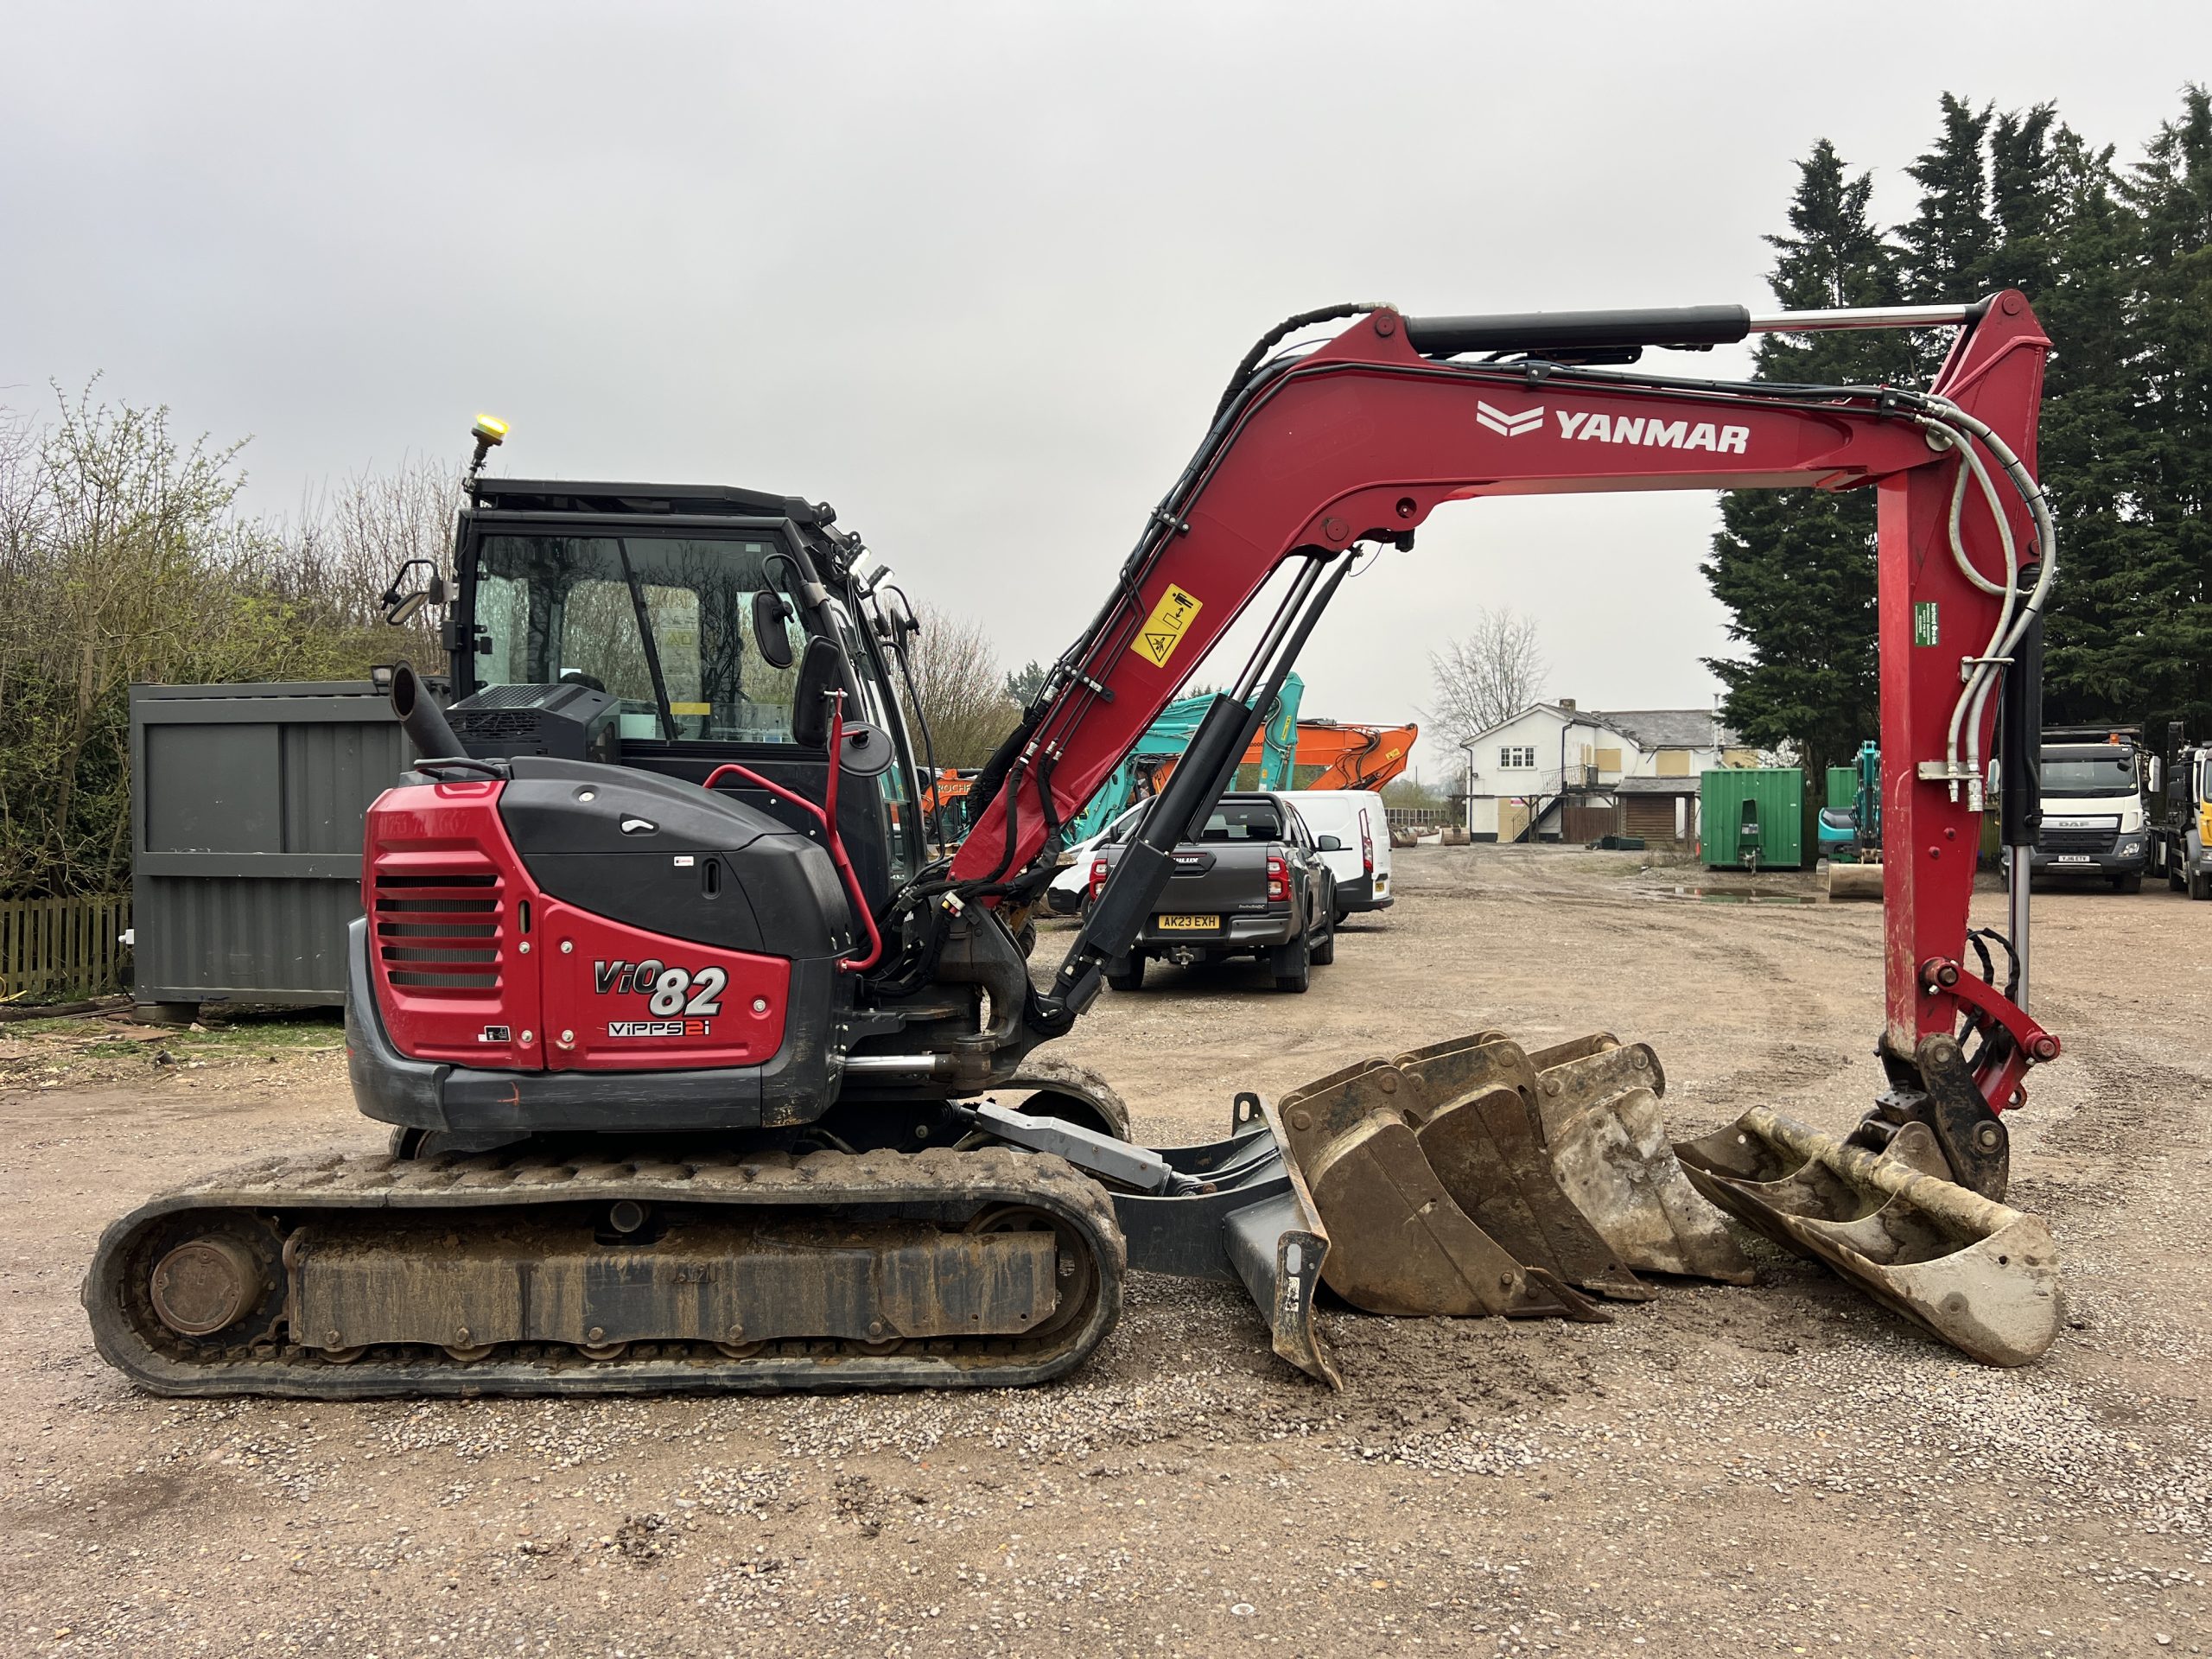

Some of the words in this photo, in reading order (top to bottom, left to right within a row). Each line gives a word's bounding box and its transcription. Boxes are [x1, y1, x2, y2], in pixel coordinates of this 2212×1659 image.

[1555, 410, 1750, 454] YANMAR
[1164, 916, 1192, 927] AK23
[1194, 916, 1216, 927] EXH
